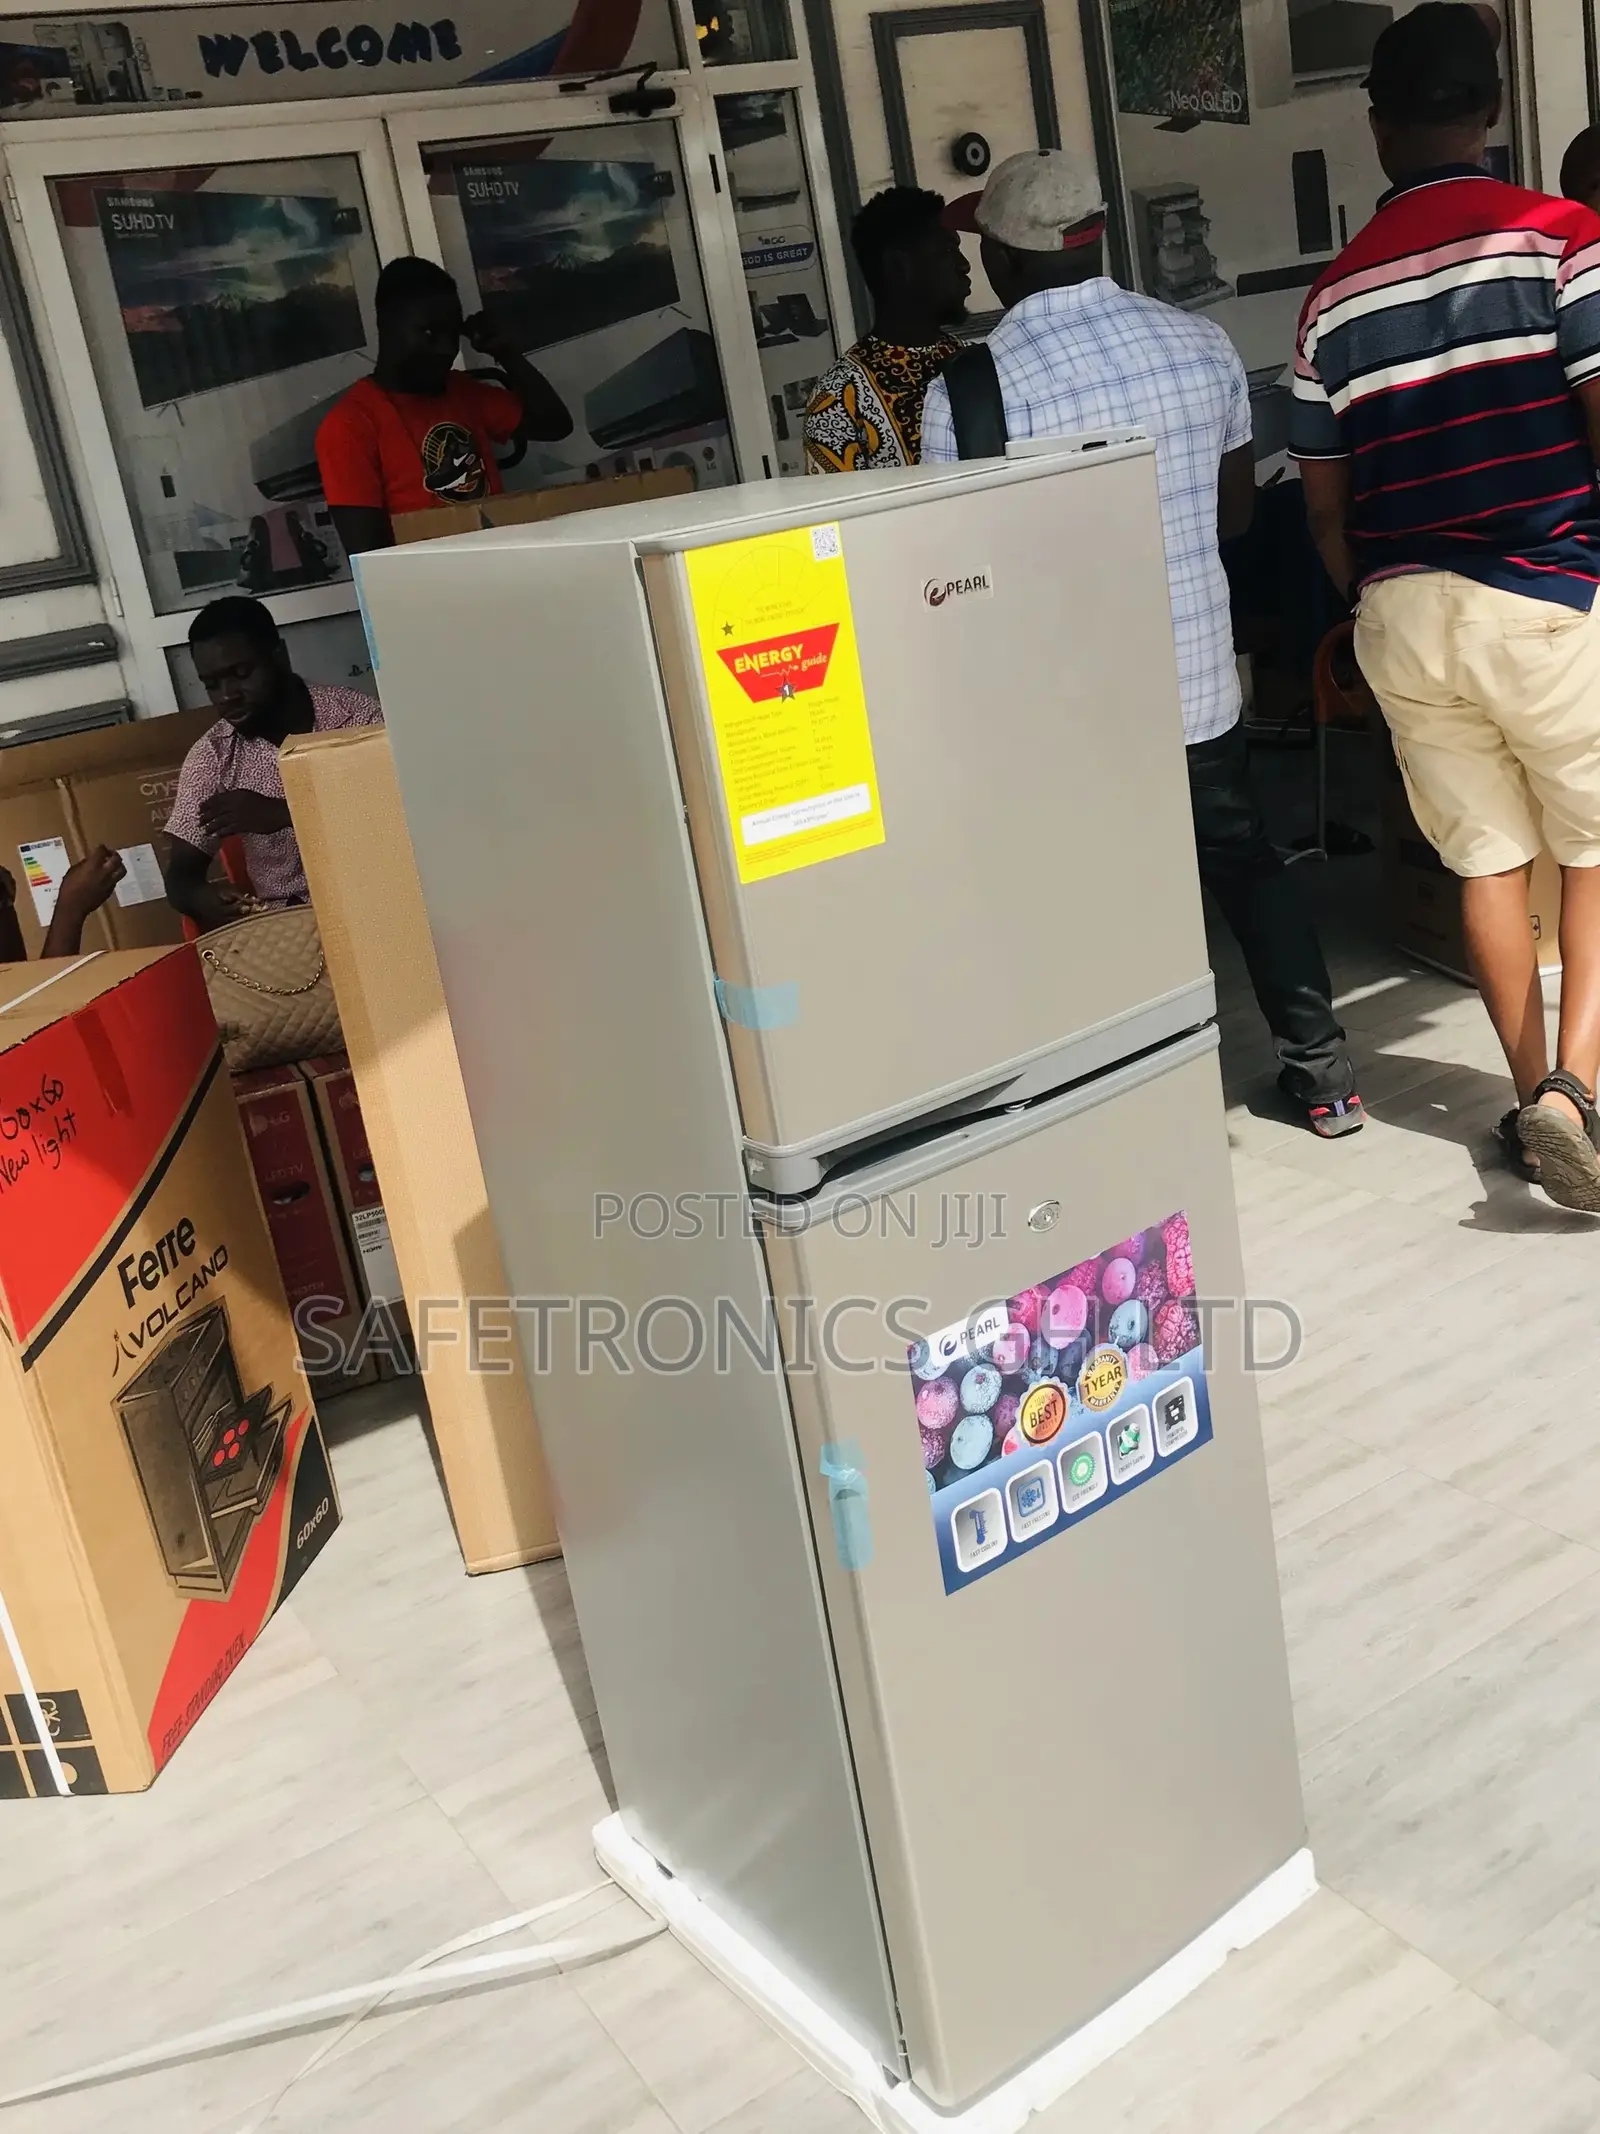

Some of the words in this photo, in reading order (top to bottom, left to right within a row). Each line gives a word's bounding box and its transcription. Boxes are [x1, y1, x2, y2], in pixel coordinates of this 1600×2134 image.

[198, 18, 463, 78] WELCOME
[1201, 90, 1242, 113] QLED
[764, 252, 774, 262] IS
[776, 247, 808, 260] GREAT
[946, 574, 990, 597] PEARL
[734, 643, 804, 675] ENERGY
[801, 653, 828, 672] guide
[31, 1107, 77, 1170] light
[117, 1217, 196, 1310] Ferre
[128, 1244, 229, 1349] VOLCANO
[960, 1317, 1001, 1345] PEARL
[1091, 1365, 1122, 1392] YEAR
[1030, 1400, 1057, 1428] BEST
[297, 1497, 329, 1549] 60x60
